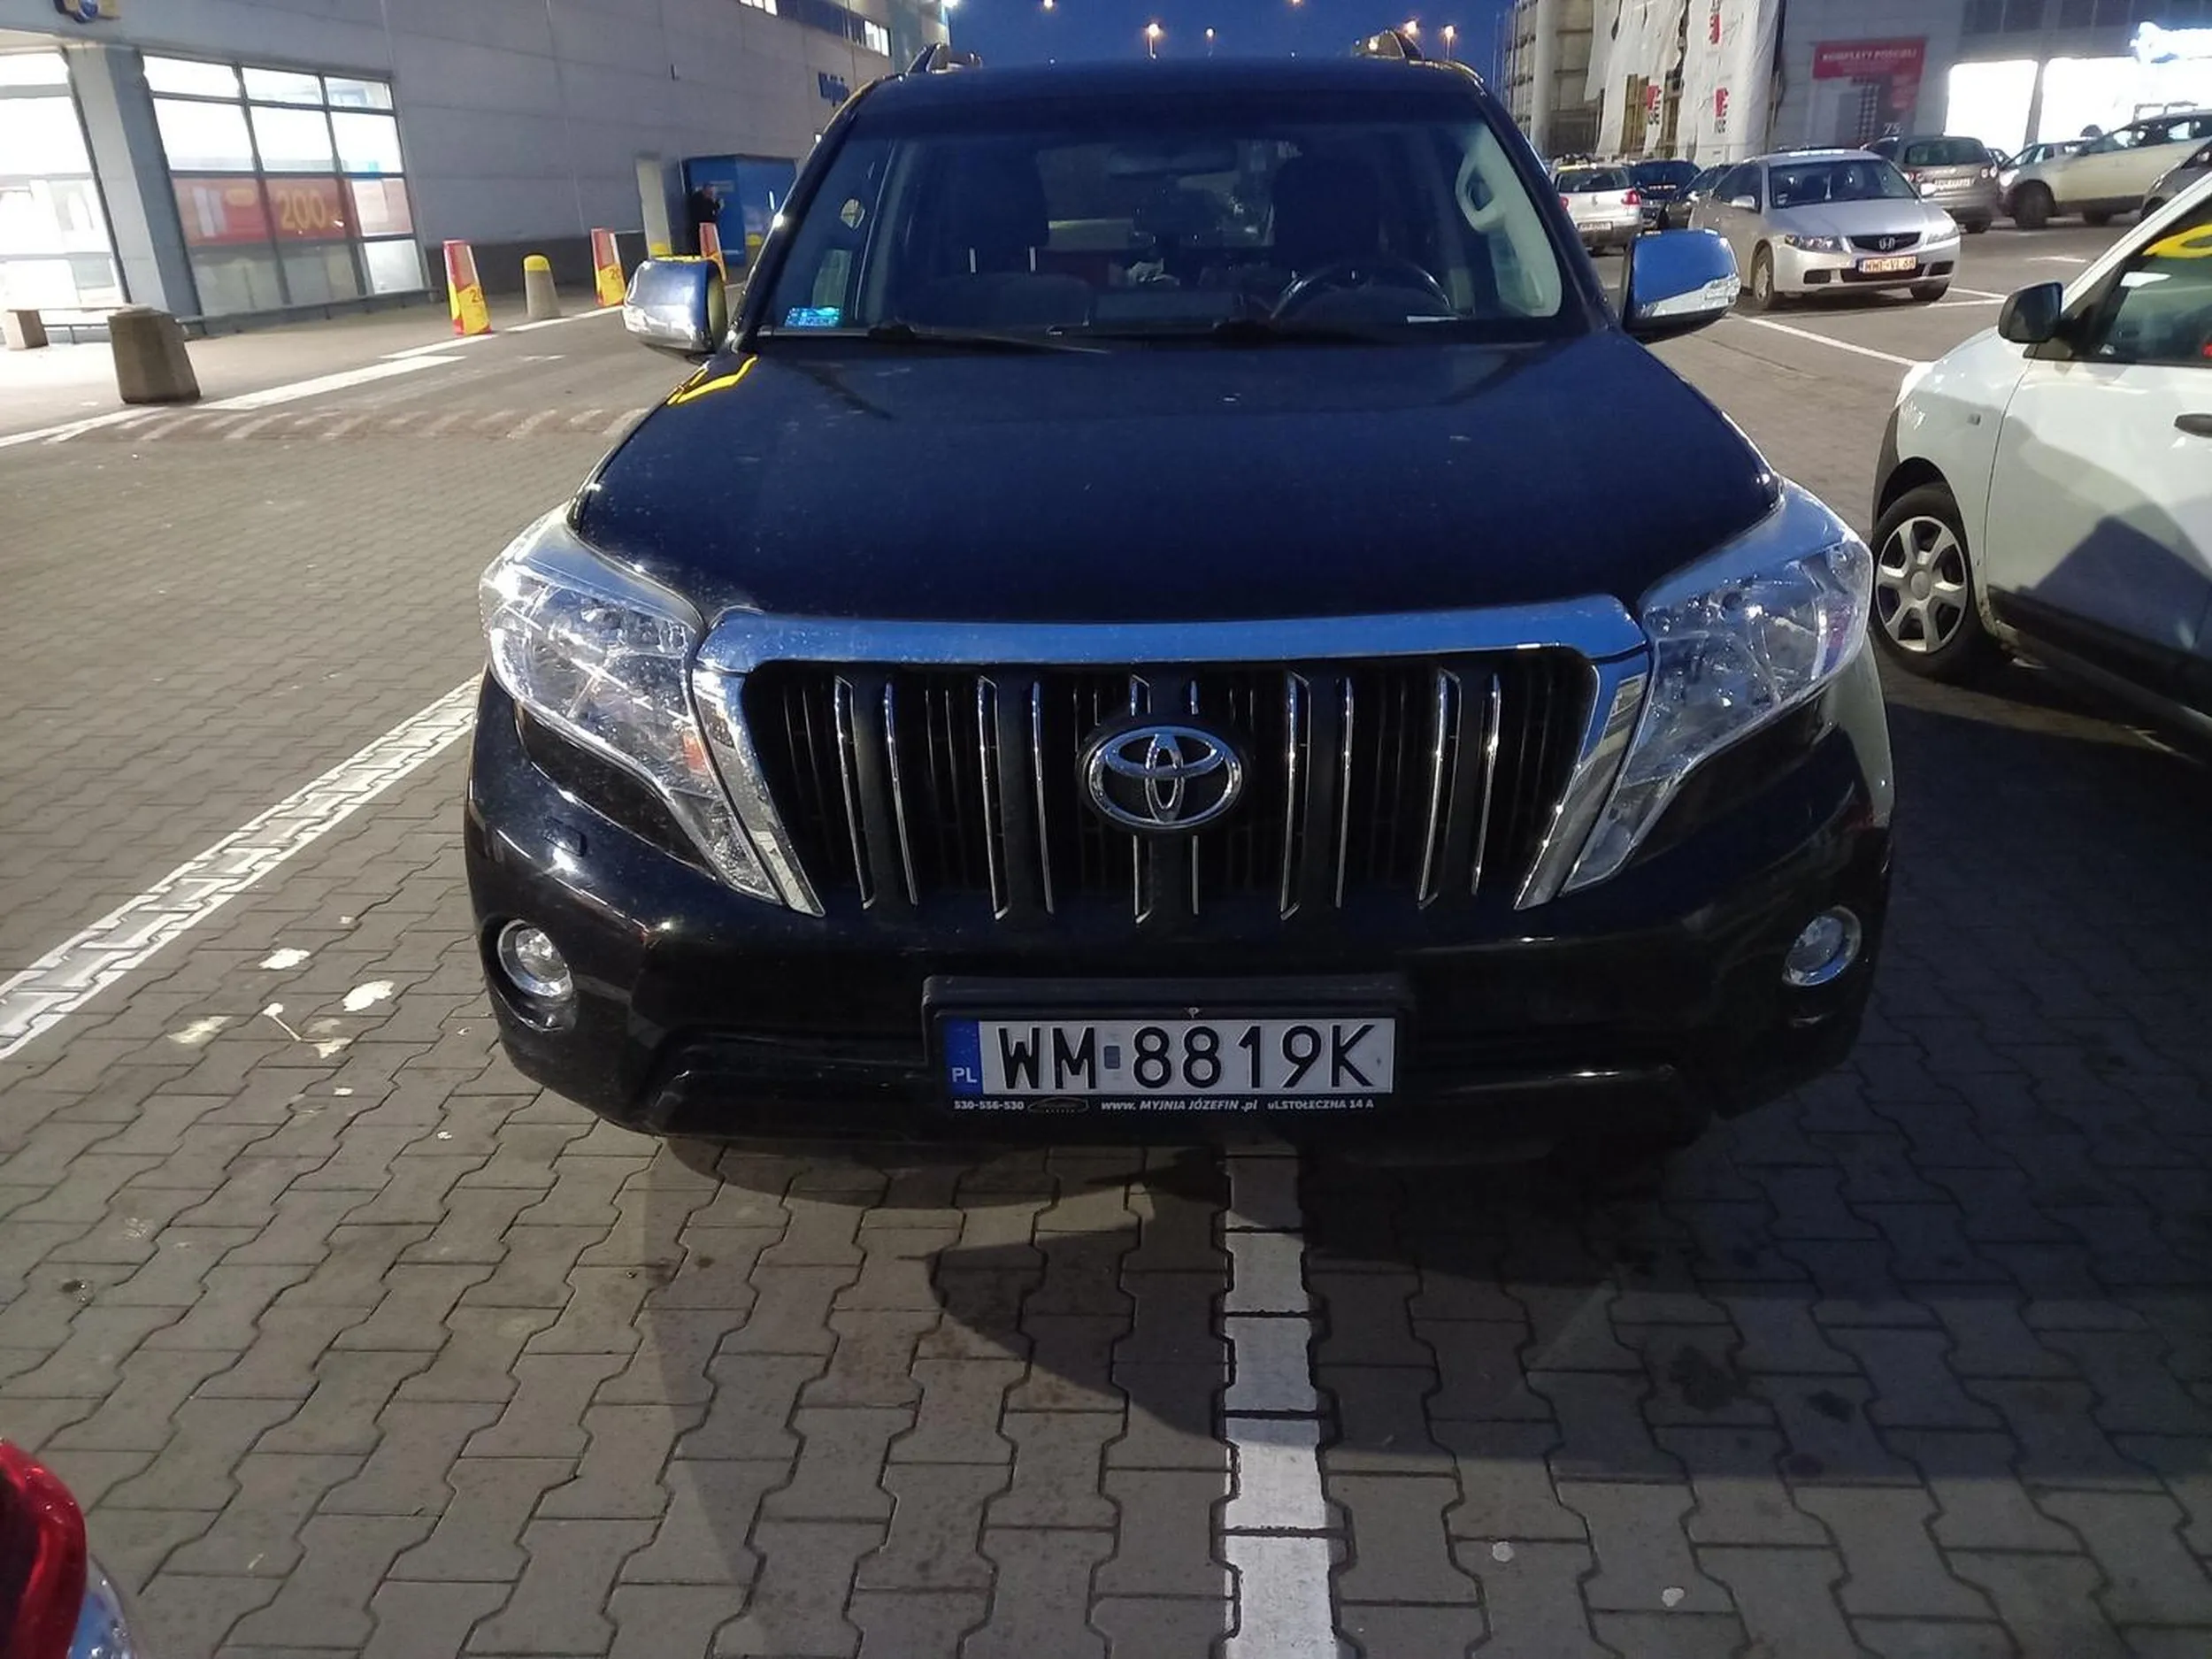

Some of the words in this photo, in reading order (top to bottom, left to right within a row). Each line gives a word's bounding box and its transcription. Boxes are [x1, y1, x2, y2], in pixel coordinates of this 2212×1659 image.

[276, 188, 326, 230] 200
[997, 1026, 1097, 1090] WM
[1133, 1024, 1375, 1089] 8819K
[952, 1067, 977, 1083] PL
[1140, 1100, 1186, 1110] MYJNIA
[1187, 1097, 1239, 1110] JÓZEFIN
[1366, 1099, 1374, 1108] A
